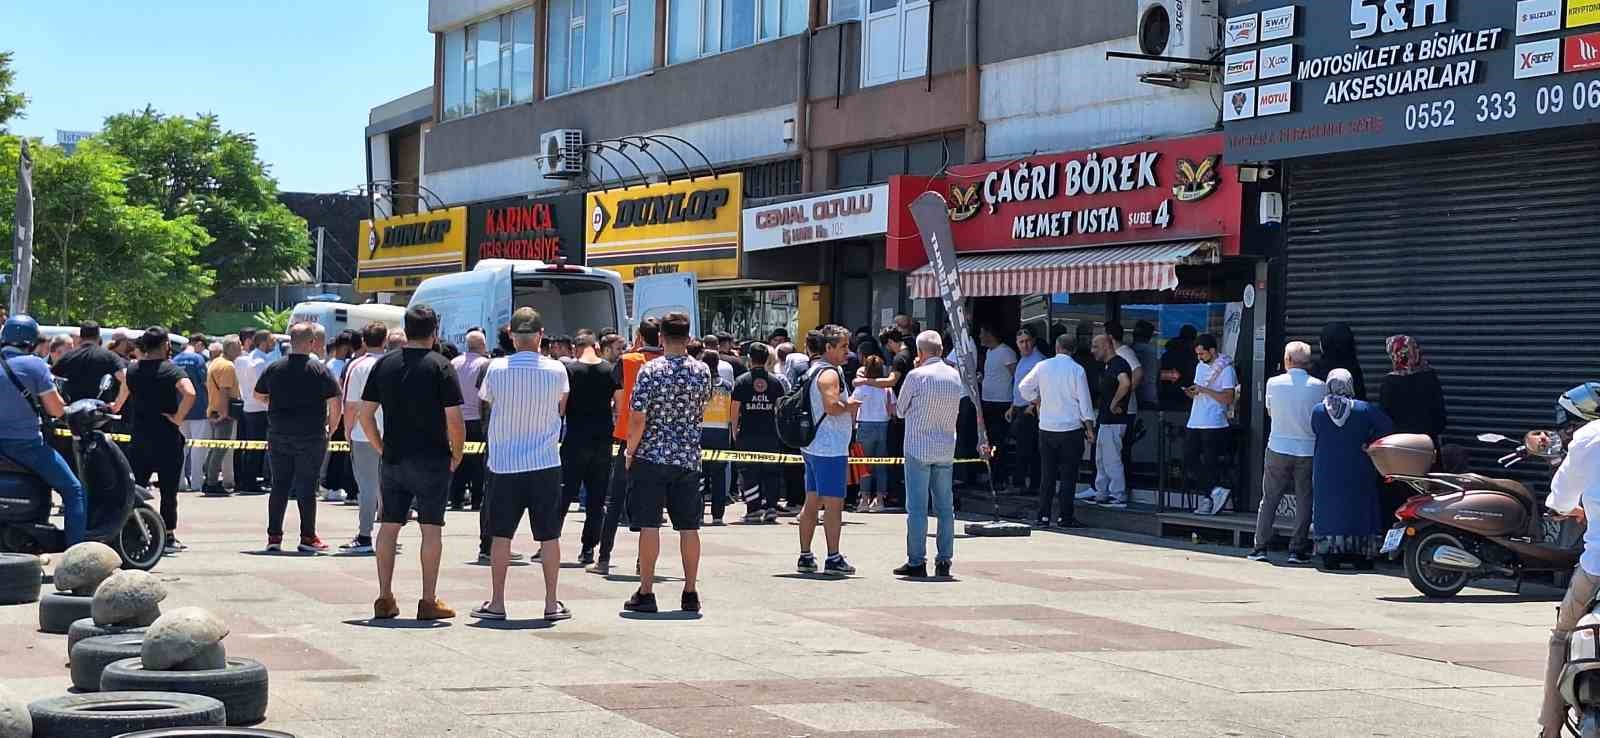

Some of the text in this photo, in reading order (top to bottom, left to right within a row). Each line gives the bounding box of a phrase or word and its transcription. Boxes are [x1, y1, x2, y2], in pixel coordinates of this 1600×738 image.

[1265, 16, 1290, 28] SWAY
[1529, 10, 1557, 20] SUZUKI
[1297, 28, 1502, 80] MOTOSİKLET & BİSİKLET
[1260, 92, 1289, 105] MOTUL
[1324, 60, 1477, 104] AKSESUARLARI
[1405, 79, 1600, 130] 0552 333 09 06
[983, 150, 1160, 215] ÇAĞRI BÖREK
[612, 188, 730, 229] DUNLOP
[756, 205, 809, 229] CEMAL
[1011, 211, 1072, 240] MEMET
[1077, 207, 1119, 234] USTA
[1155, 199, 1170, 229] 4
[381, 219, 452, 249] DUNLOP
